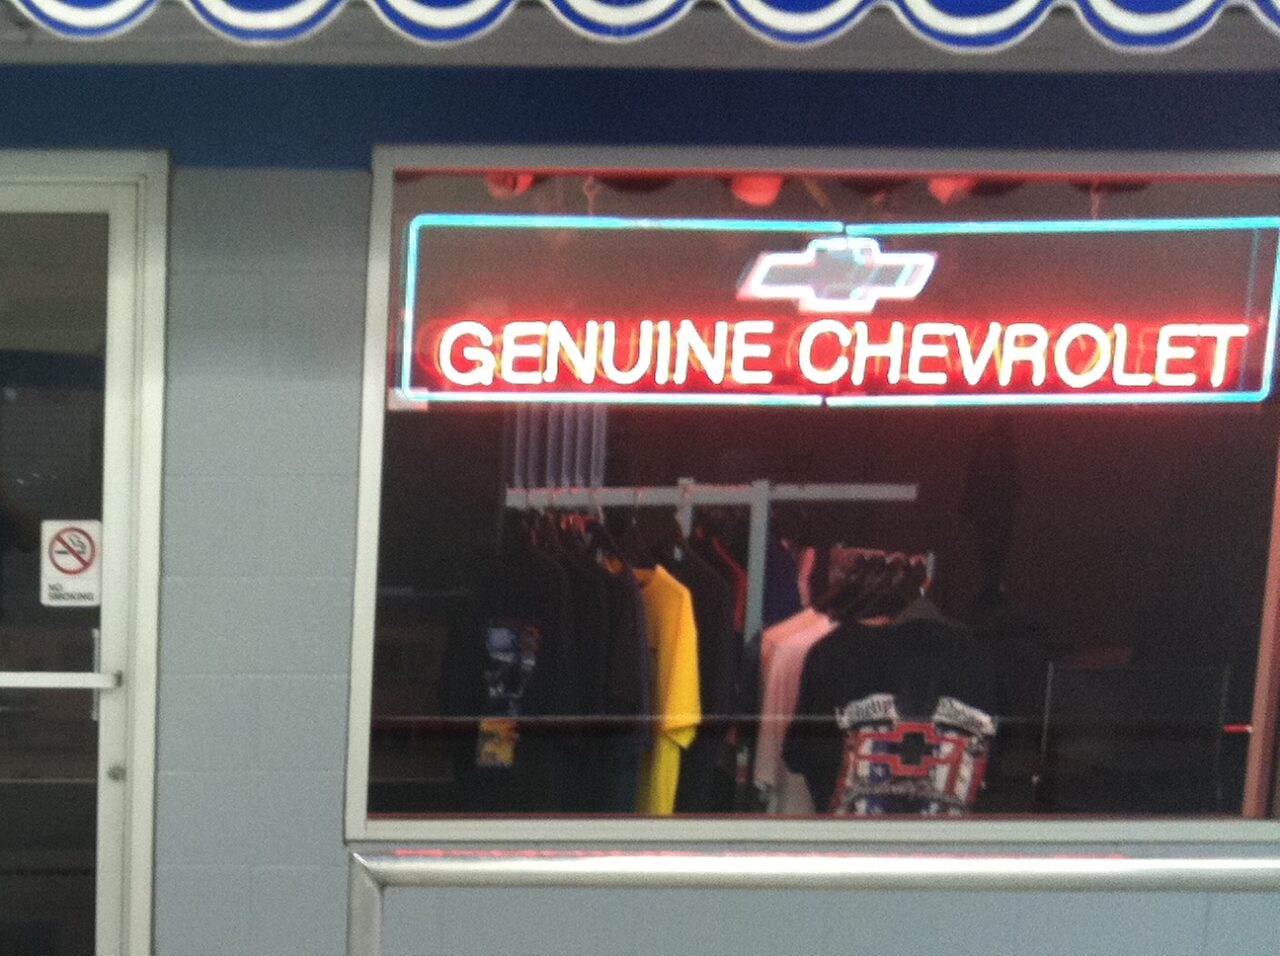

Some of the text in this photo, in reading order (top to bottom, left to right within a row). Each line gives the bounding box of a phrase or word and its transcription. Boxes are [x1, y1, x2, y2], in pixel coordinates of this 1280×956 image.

[439, 319, 1249, 388] GENUINE CHEVROLET
[48, 583, 63, 591] NO
[48, 592, 95, 601] SMOKING
